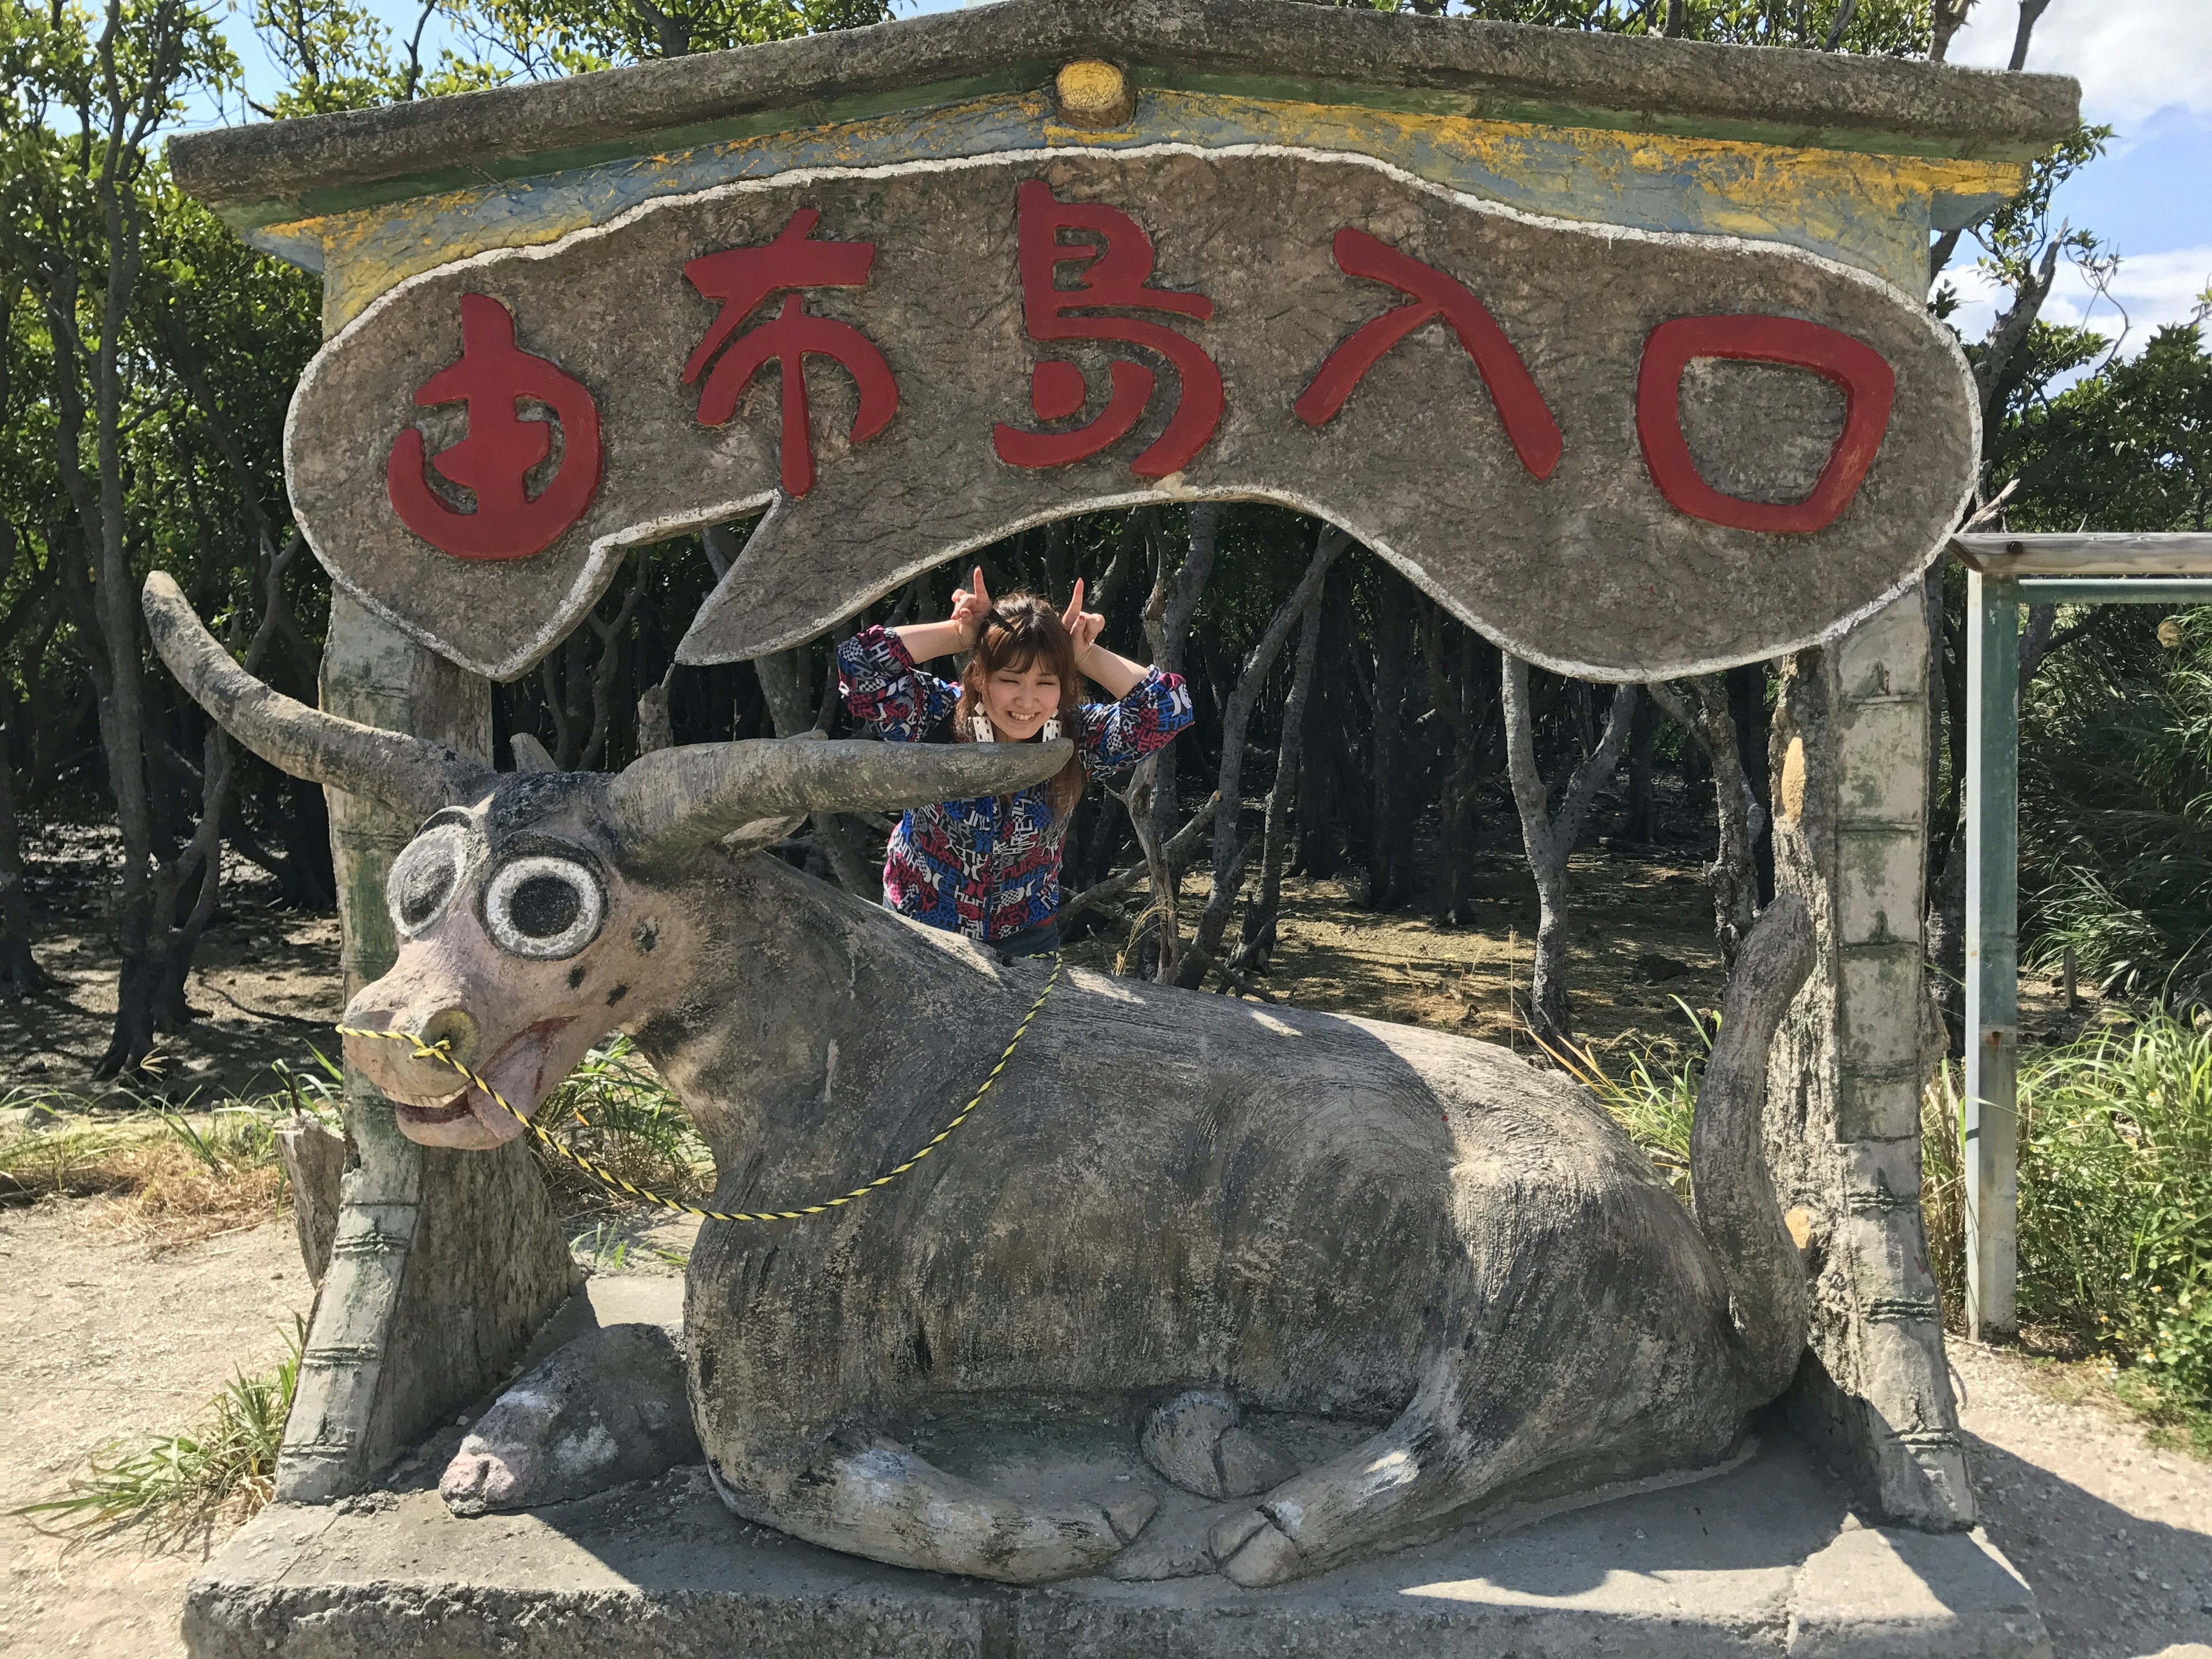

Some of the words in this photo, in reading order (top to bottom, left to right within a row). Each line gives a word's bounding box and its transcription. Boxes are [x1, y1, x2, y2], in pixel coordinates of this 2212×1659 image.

[388, 181, 1895, 559] 由布島入口
